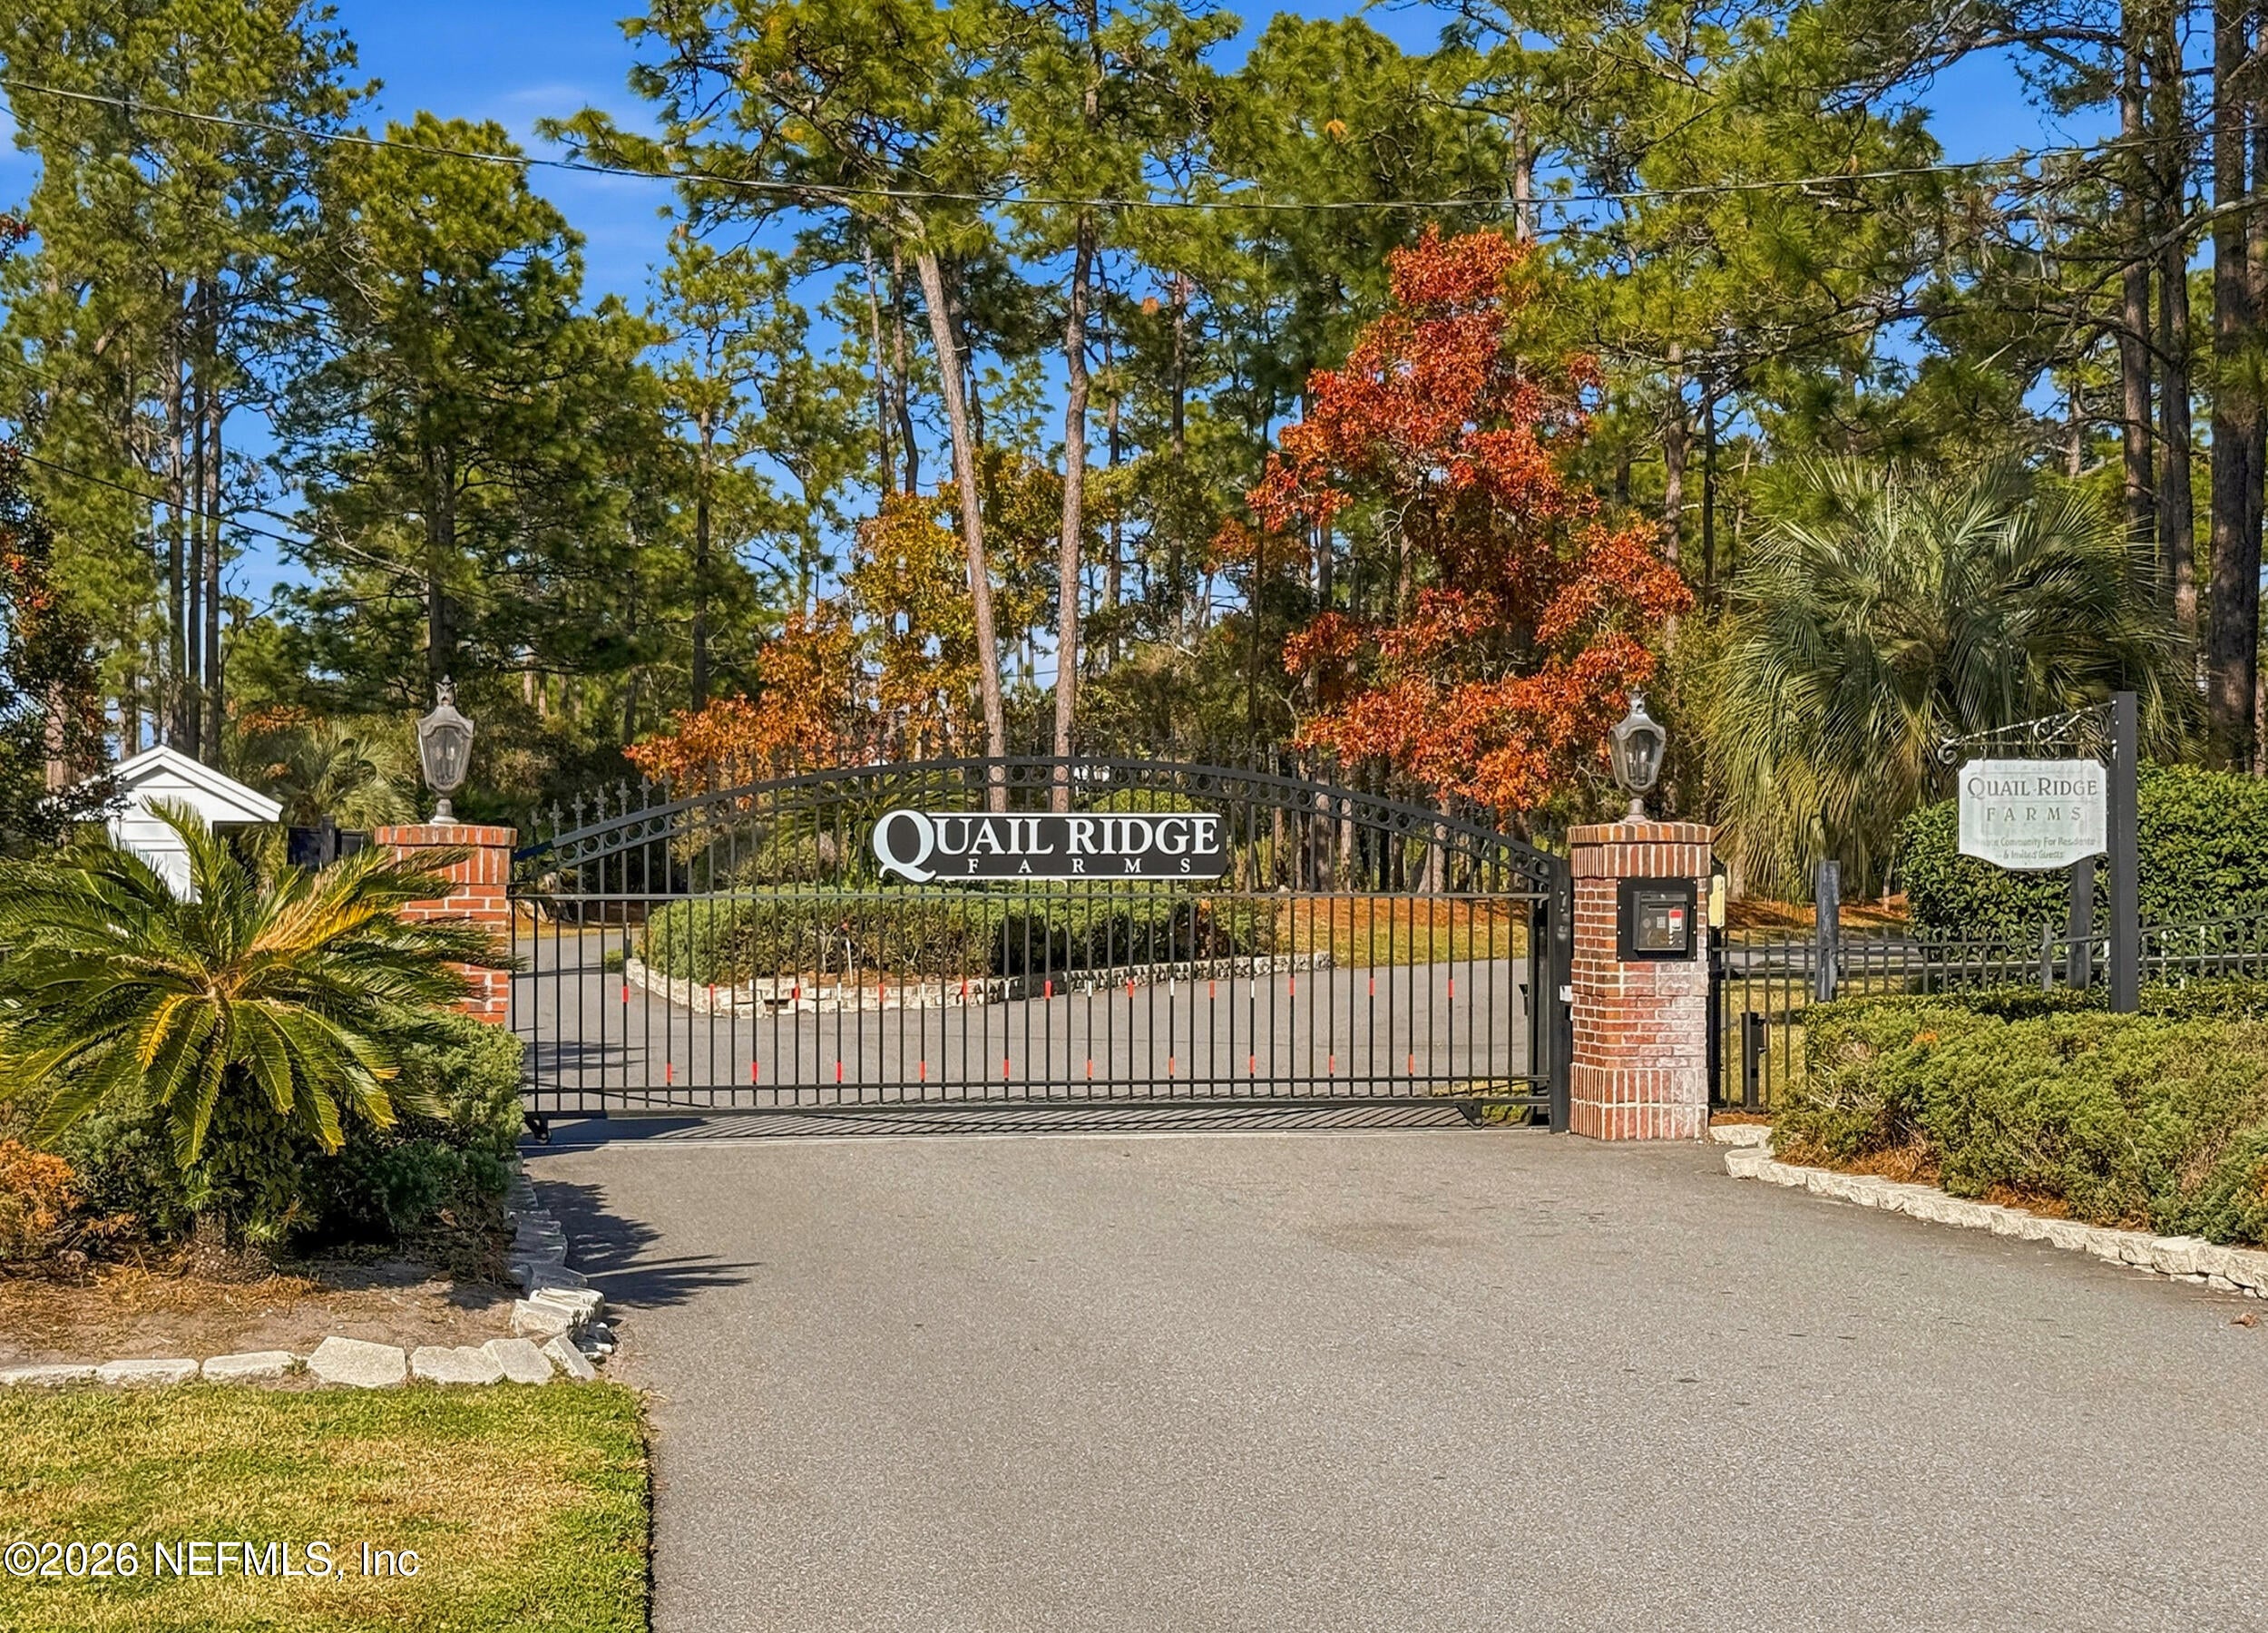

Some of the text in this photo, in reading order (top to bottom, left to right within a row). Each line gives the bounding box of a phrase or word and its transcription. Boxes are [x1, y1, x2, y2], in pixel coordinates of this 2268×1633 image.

[1968, 777, 2097, 800] QUAIL RIDGE
[1987, 807, 2081, 821] FARMS
[873, 809, 1219, 883] QUAIL RIDGE
[2044, 836, 2056, 847] For
[968, 858, 1191, 874] FARMS
